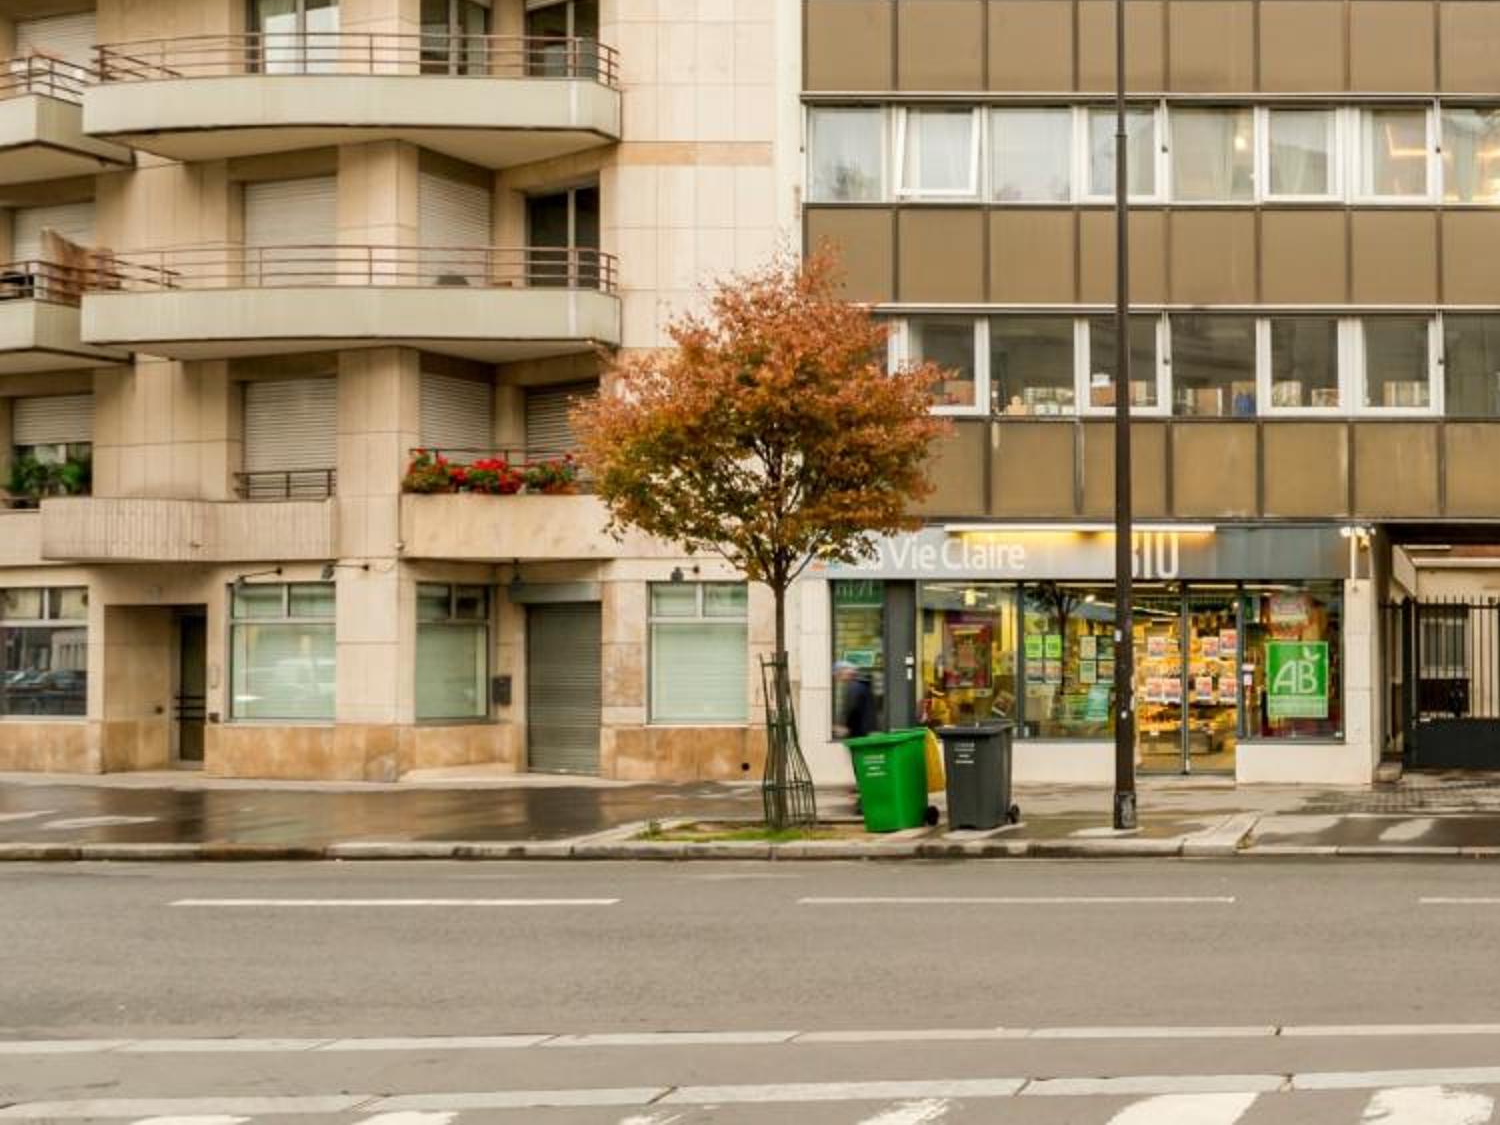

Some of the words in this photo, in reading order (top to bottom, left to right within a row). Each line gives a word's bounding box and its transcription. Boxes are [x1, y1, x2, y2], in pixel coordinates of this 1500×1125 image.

[887, 535, 937, 570] Vie
[941, 536, 1026, 570] Claire
[1272, 659, 1319, 694] AB
